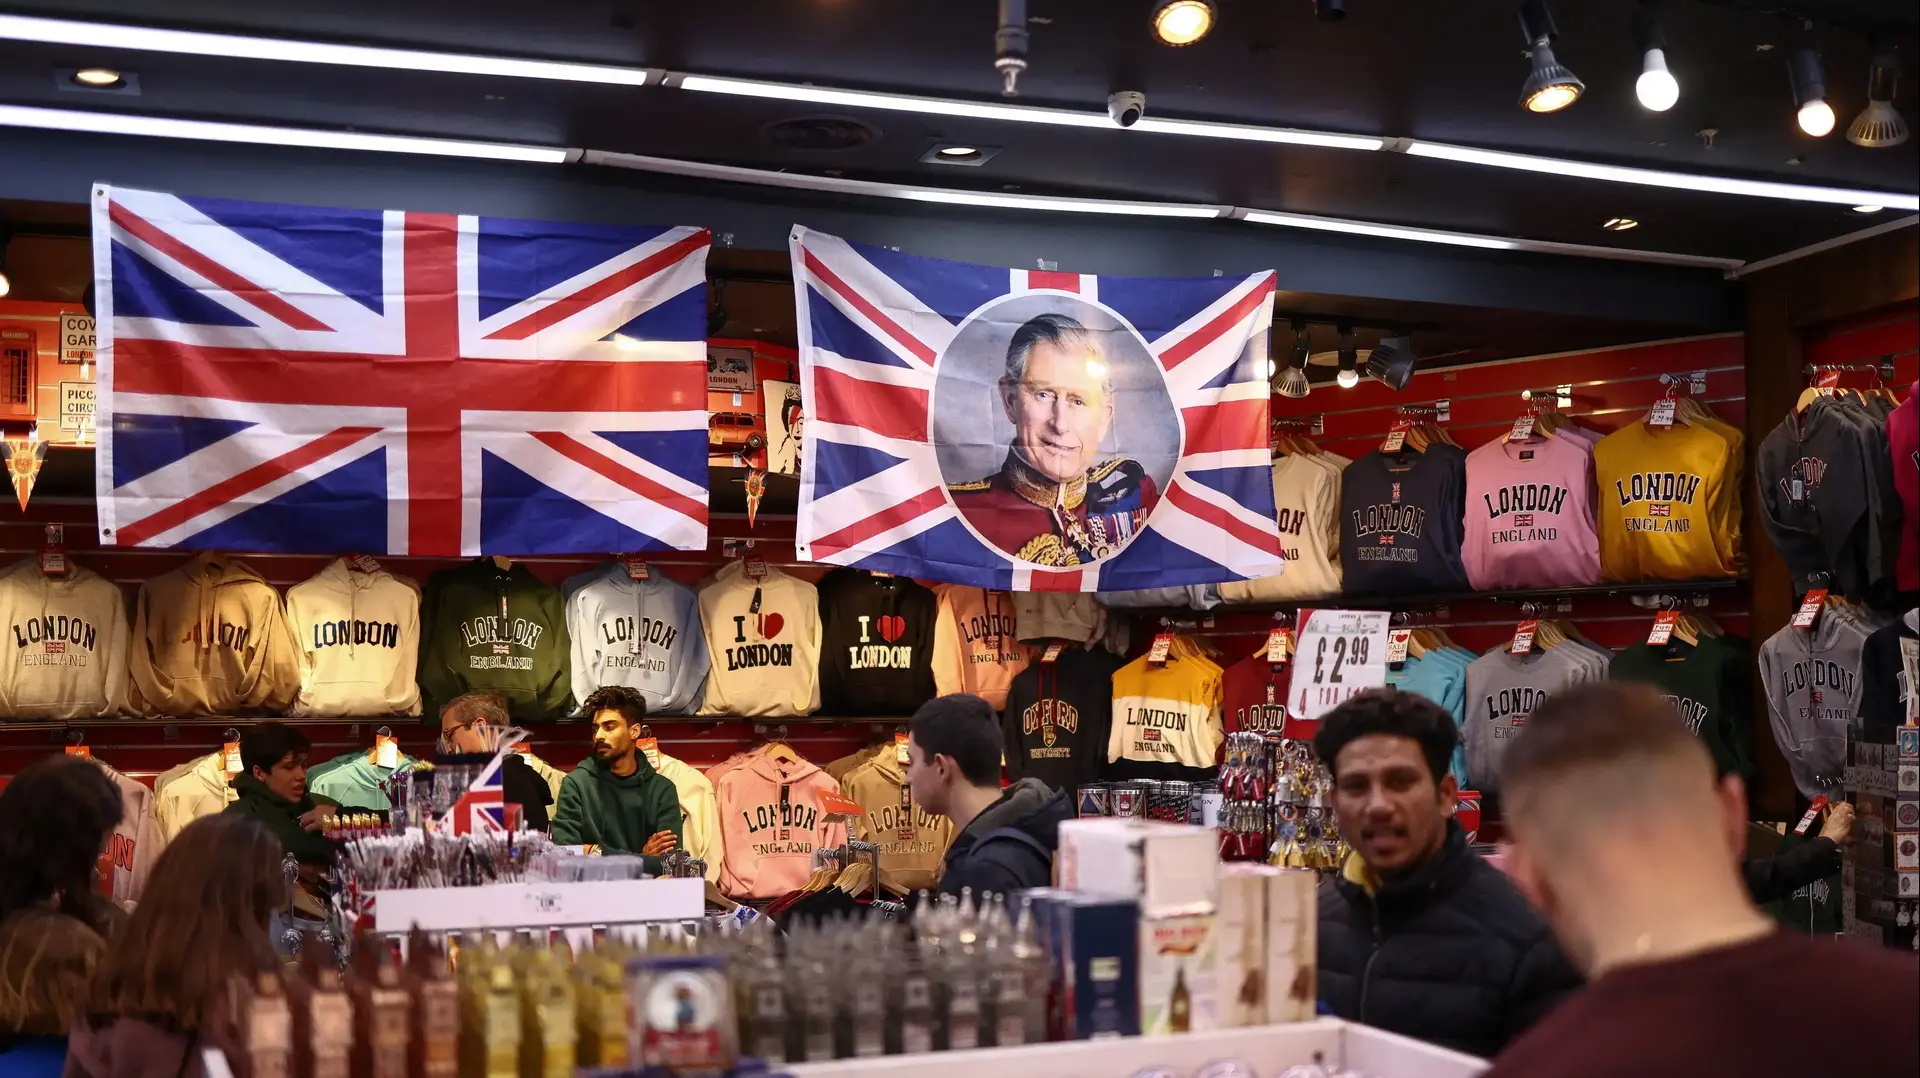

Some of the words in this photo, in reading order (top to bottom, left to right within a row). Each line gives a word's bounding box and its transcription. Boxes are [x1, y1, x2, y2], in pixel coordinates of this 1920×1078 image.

[66, 350, 94, 359] LONDON
[709, 376, 738, 385] LONDON
[67, 389, 96, 400] PICC
[1484, 483, 1568, 519] LONDON
[1616, 472, 1700, 507] LONDON
[1278, 507, 1305, 536] ON
[1352, 504, 1426, 539] LONDON
[1624, 517, 1690, 532] ENGLAND
[1491, 527, 1558, 544] ENGLAND
[1281, 548, 1299, 561] ND
[1358, 546, 1419, 562] ENGLAND
[13, 615, 97, 652] LONDON
[313, 619, 399, 649] LONDON
[733, 616, 747, 643] I
[858, 616, 871, 643] I
[23, 653, 88, 667] ENGLAND
[469, 656, 534, 670] ENGLAND
[726, 644, 793, 671] LONDON
[850, 646, 912, 669] LONDON
[1313, 636, 1369, 684] £2.99
[1783, 658, 1854, 704] LONDON
[1486, 686, 1552, 720] LONDO
[1799, 707, 1851, 719] ELAND
[1126, 707, 1187, 732] LONDON
[1134, 741, 1176, 754] ENGLAND
[742, 804, 818, 833] LONDON
[752, 841, 812, 855] ENGLAND
[879, 841, 936, 855] ENGLAND
